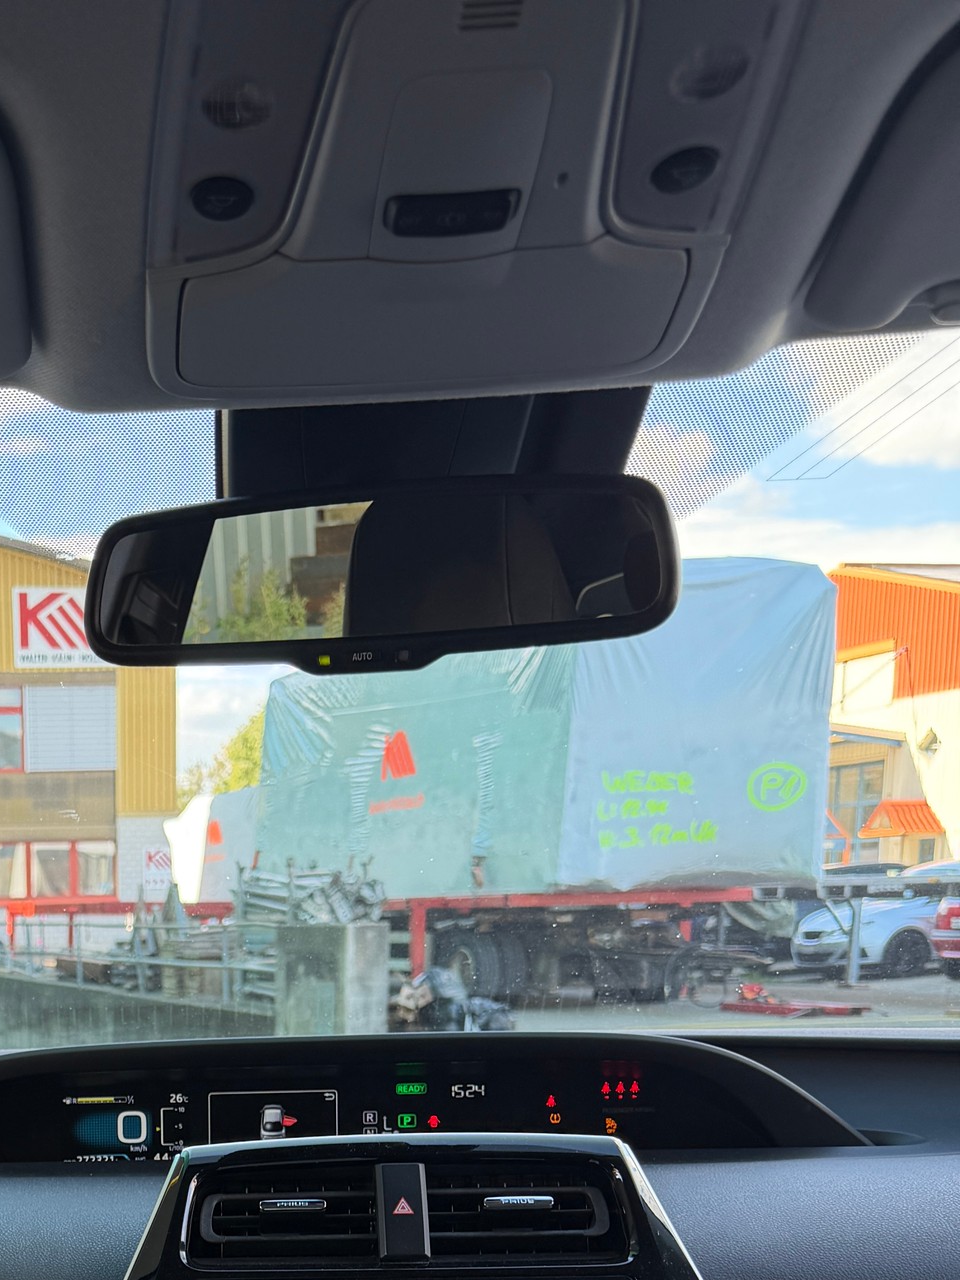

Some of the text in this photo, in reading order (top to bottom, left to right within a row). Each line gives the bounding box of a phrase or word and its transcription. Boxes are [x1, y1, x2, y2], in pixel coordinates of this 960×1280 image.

[352, 652, 373, 661] AUTO
[397, 1084, 425, 1093] READY
[117, 1110, 147, 1144] 0
[129, 1145, 148, 1153] km/h
